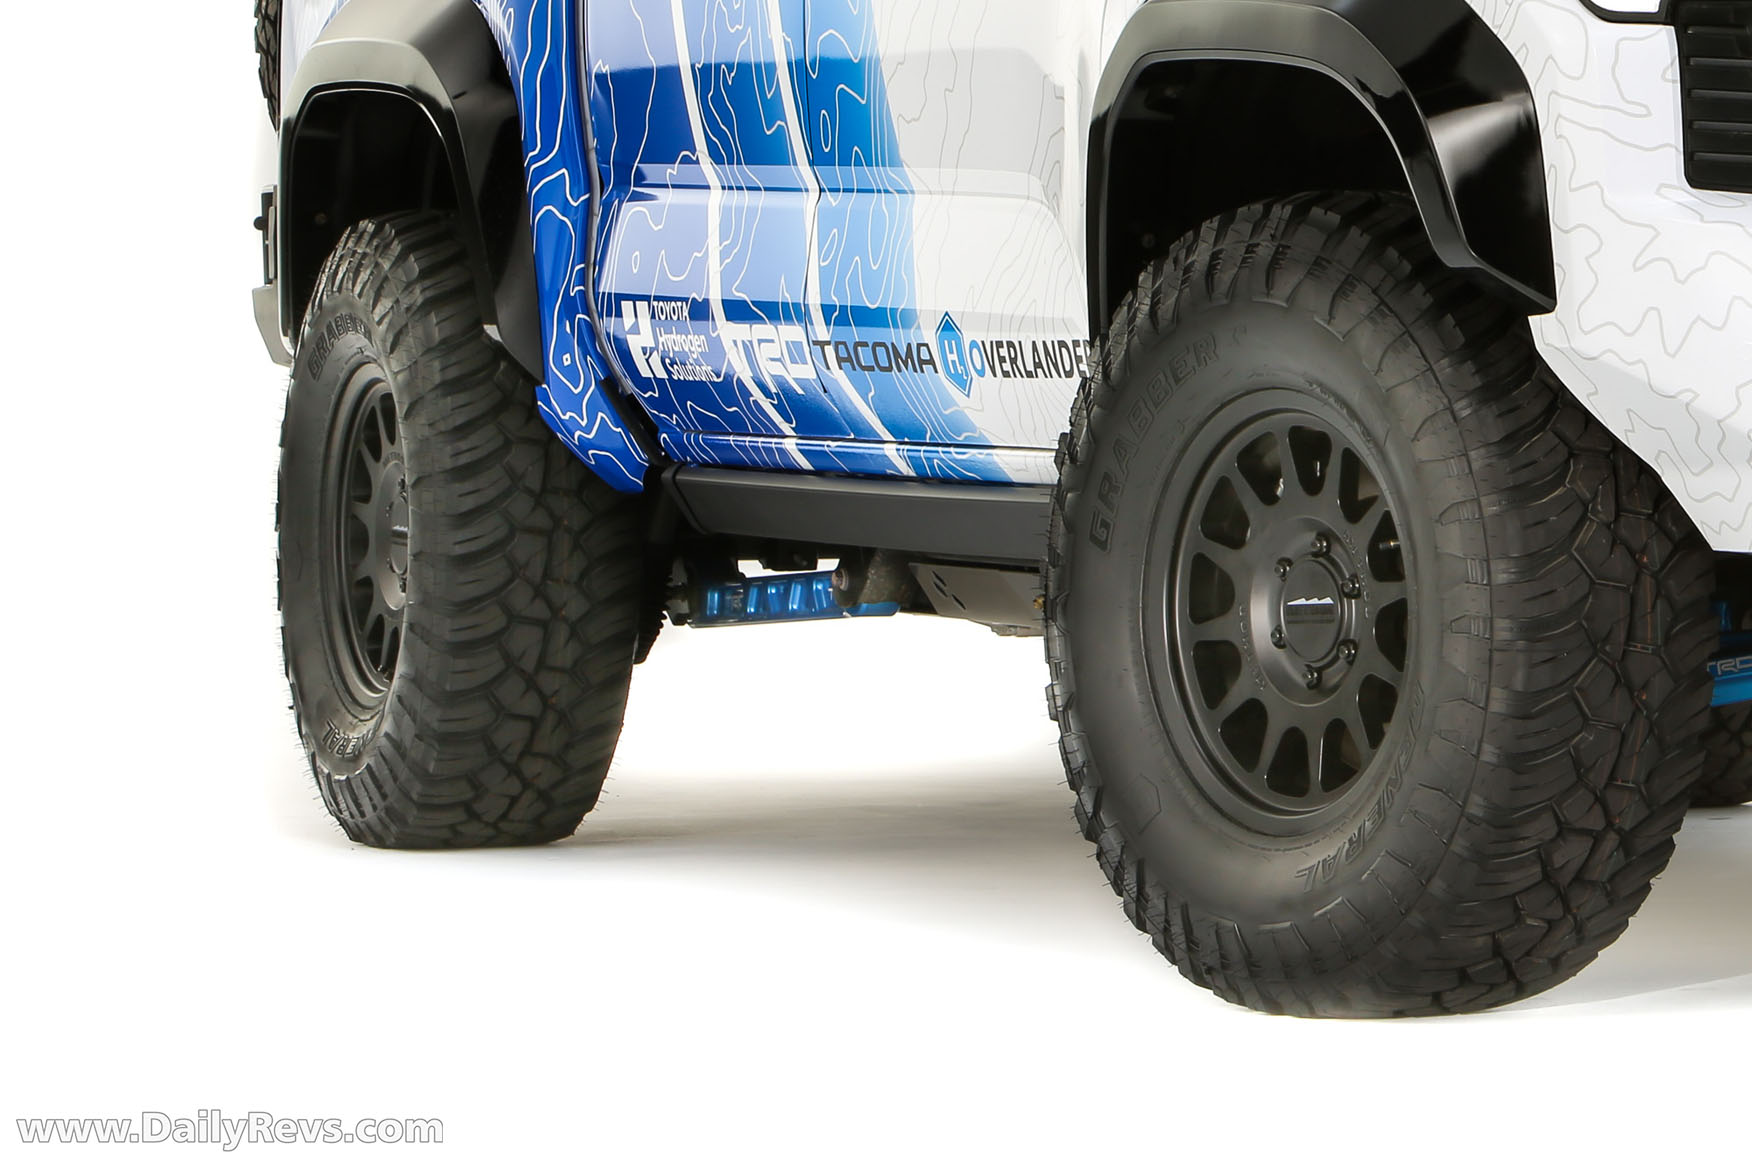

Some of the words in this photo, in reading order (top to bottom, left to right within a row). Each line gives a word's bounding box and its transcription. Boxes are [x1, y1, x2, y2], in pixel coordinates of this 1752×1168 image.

[653, 301, 689, 321] TOYOTA
[656, 325, 709, 358] Hydrogen
[665, 356, 715, 382] Solutions
[719, 323, 818, 395] TRD
[812, 340, 939, 374] TACOMA
[1088, 334, 1221, 553] GRABBER
